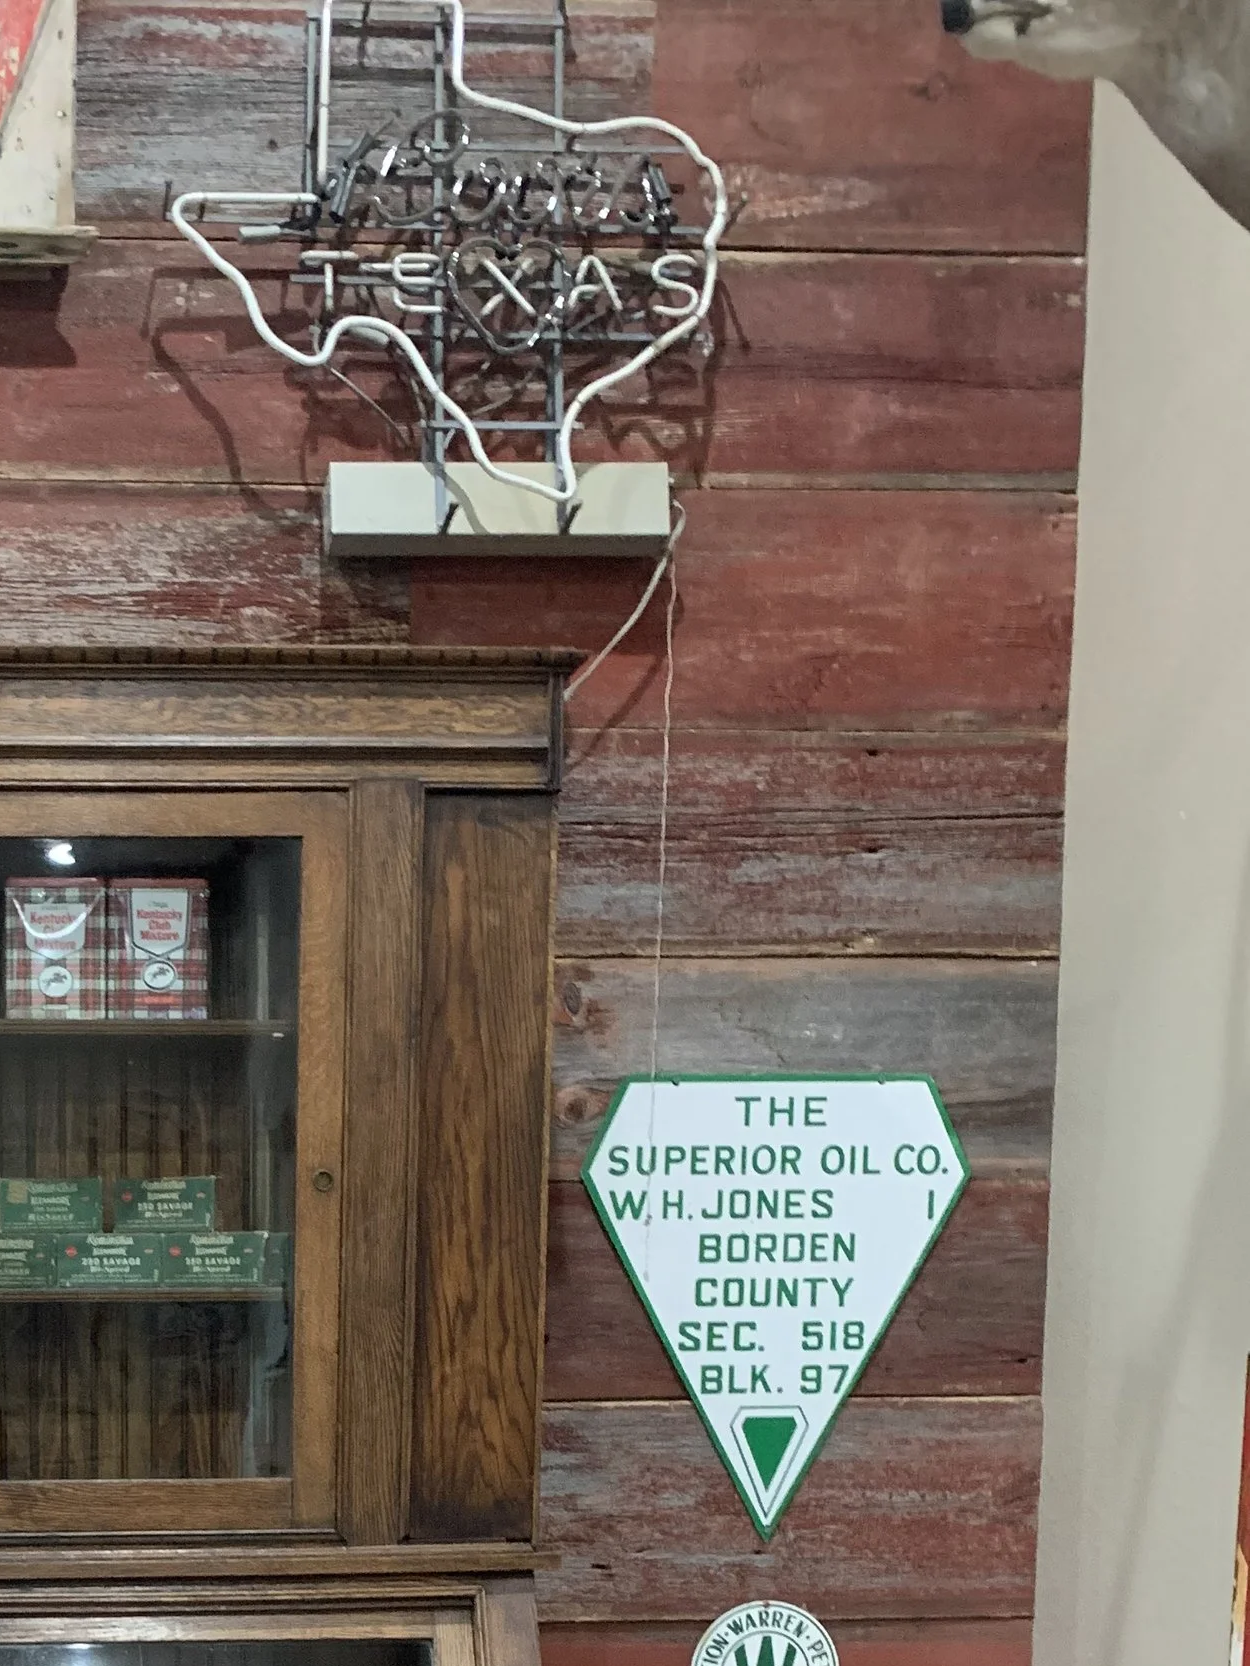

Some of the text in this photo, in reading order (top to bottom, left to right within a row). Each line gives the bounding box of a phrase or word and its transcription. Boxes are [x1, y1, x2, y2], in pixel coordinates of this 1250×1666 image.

[300, 250, 699, 318] TEXAS
[735, 1096, 828, 1127] THE
[607, 1143, 949, 1177] SUPERIOR OIL CO.
[698, 1233, 856, 1263] BORDEN
[695, 1277, 854, 1308] COUNTY
[678, 1321, 865, 1352] SEC. 518
[699, 1363, 850, 1395] BLK. 97
[726, 1610, 809, 1638] WARREN
